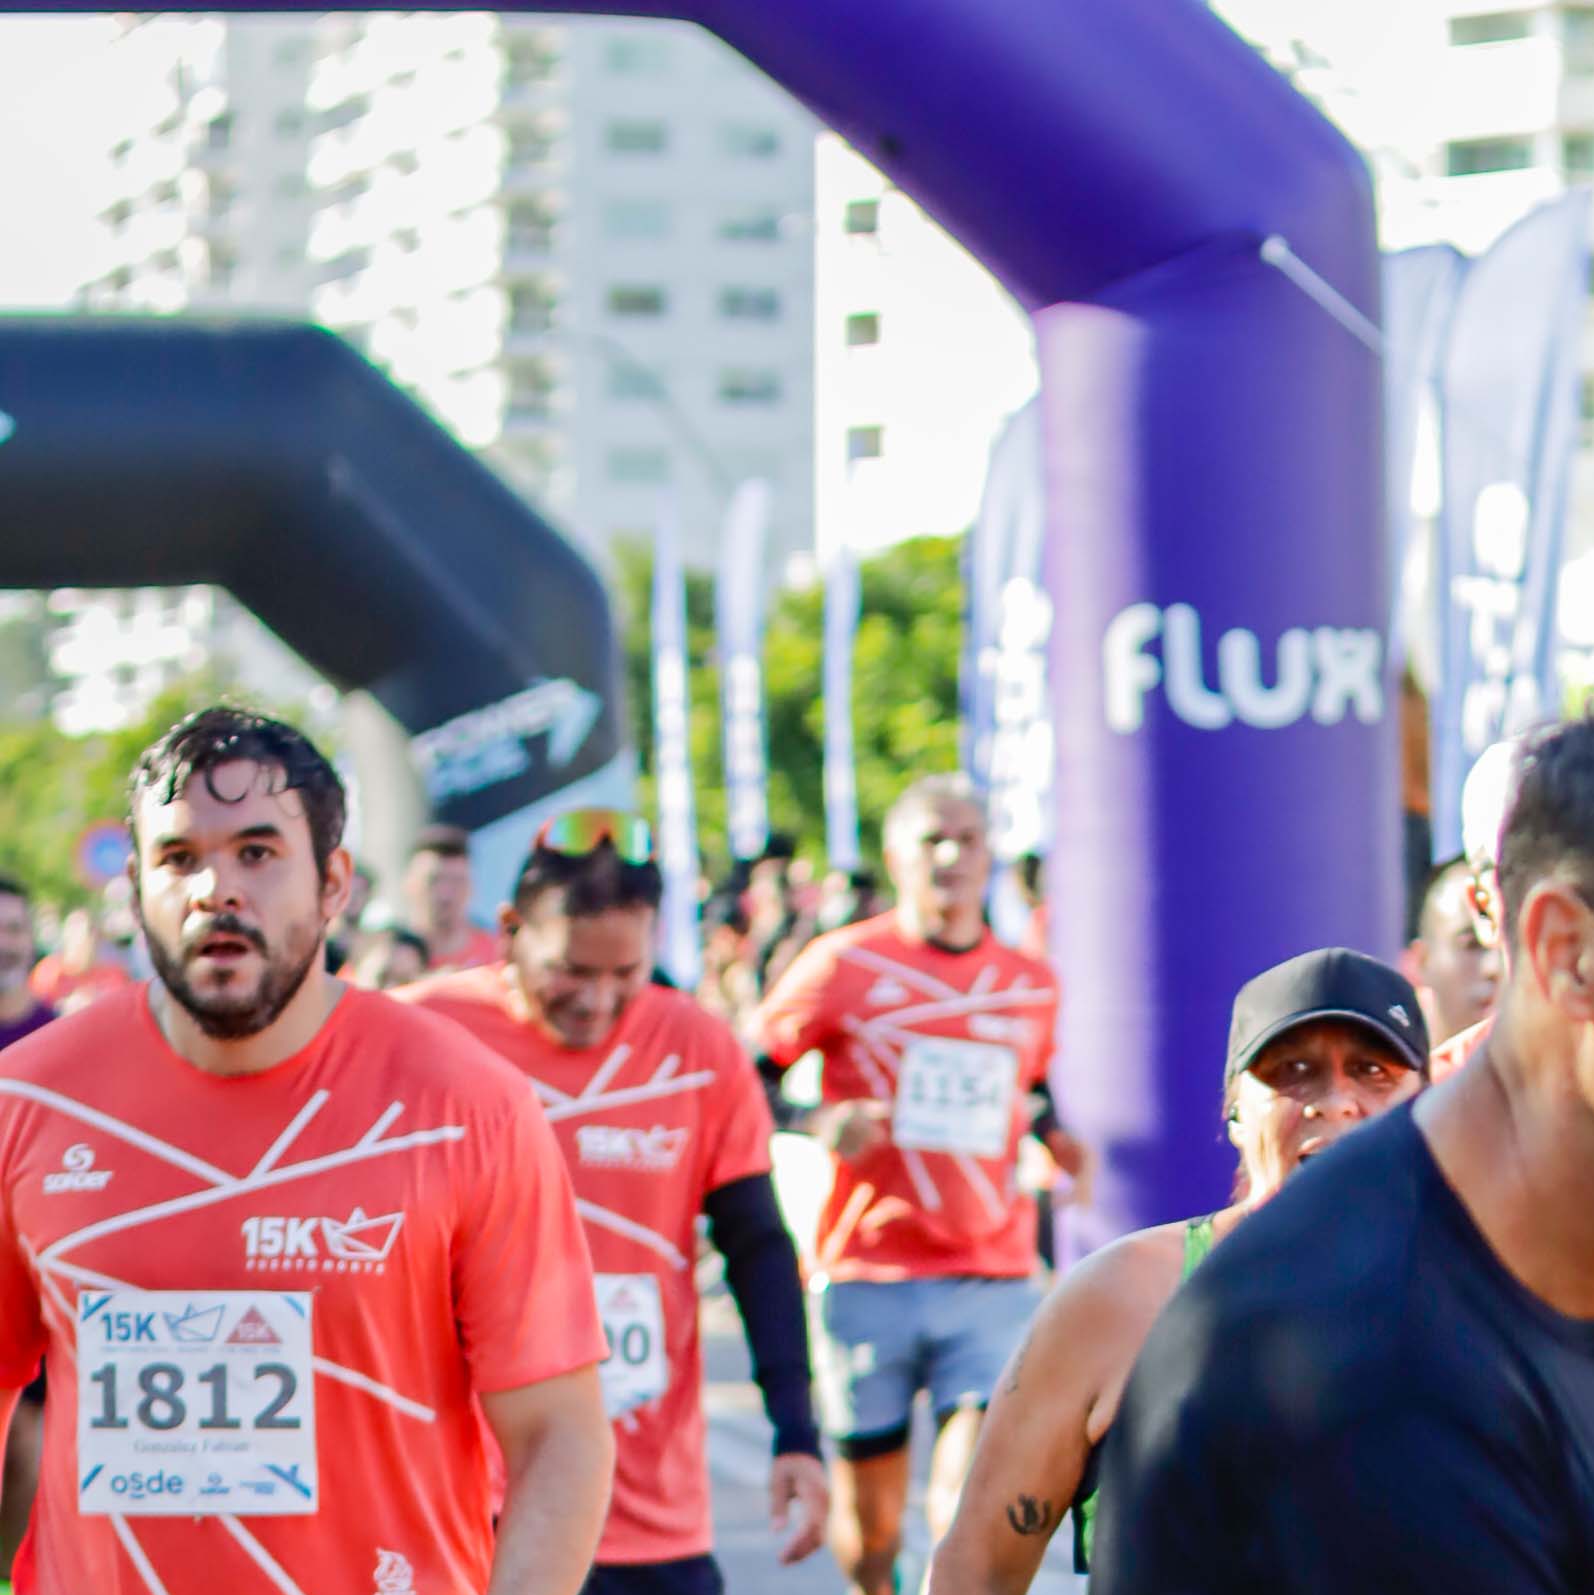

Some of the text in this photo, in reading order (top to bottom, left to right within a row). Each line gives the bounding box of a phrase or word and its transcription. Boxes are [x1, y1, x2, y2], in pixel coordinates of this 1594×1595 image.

[241, 1217, 318, 1257] 15K
[100, 1311, 157, 1342] 15K
[90, 1361, 302, 1431] 1812
[111, 1469, 184, 1500] osde
